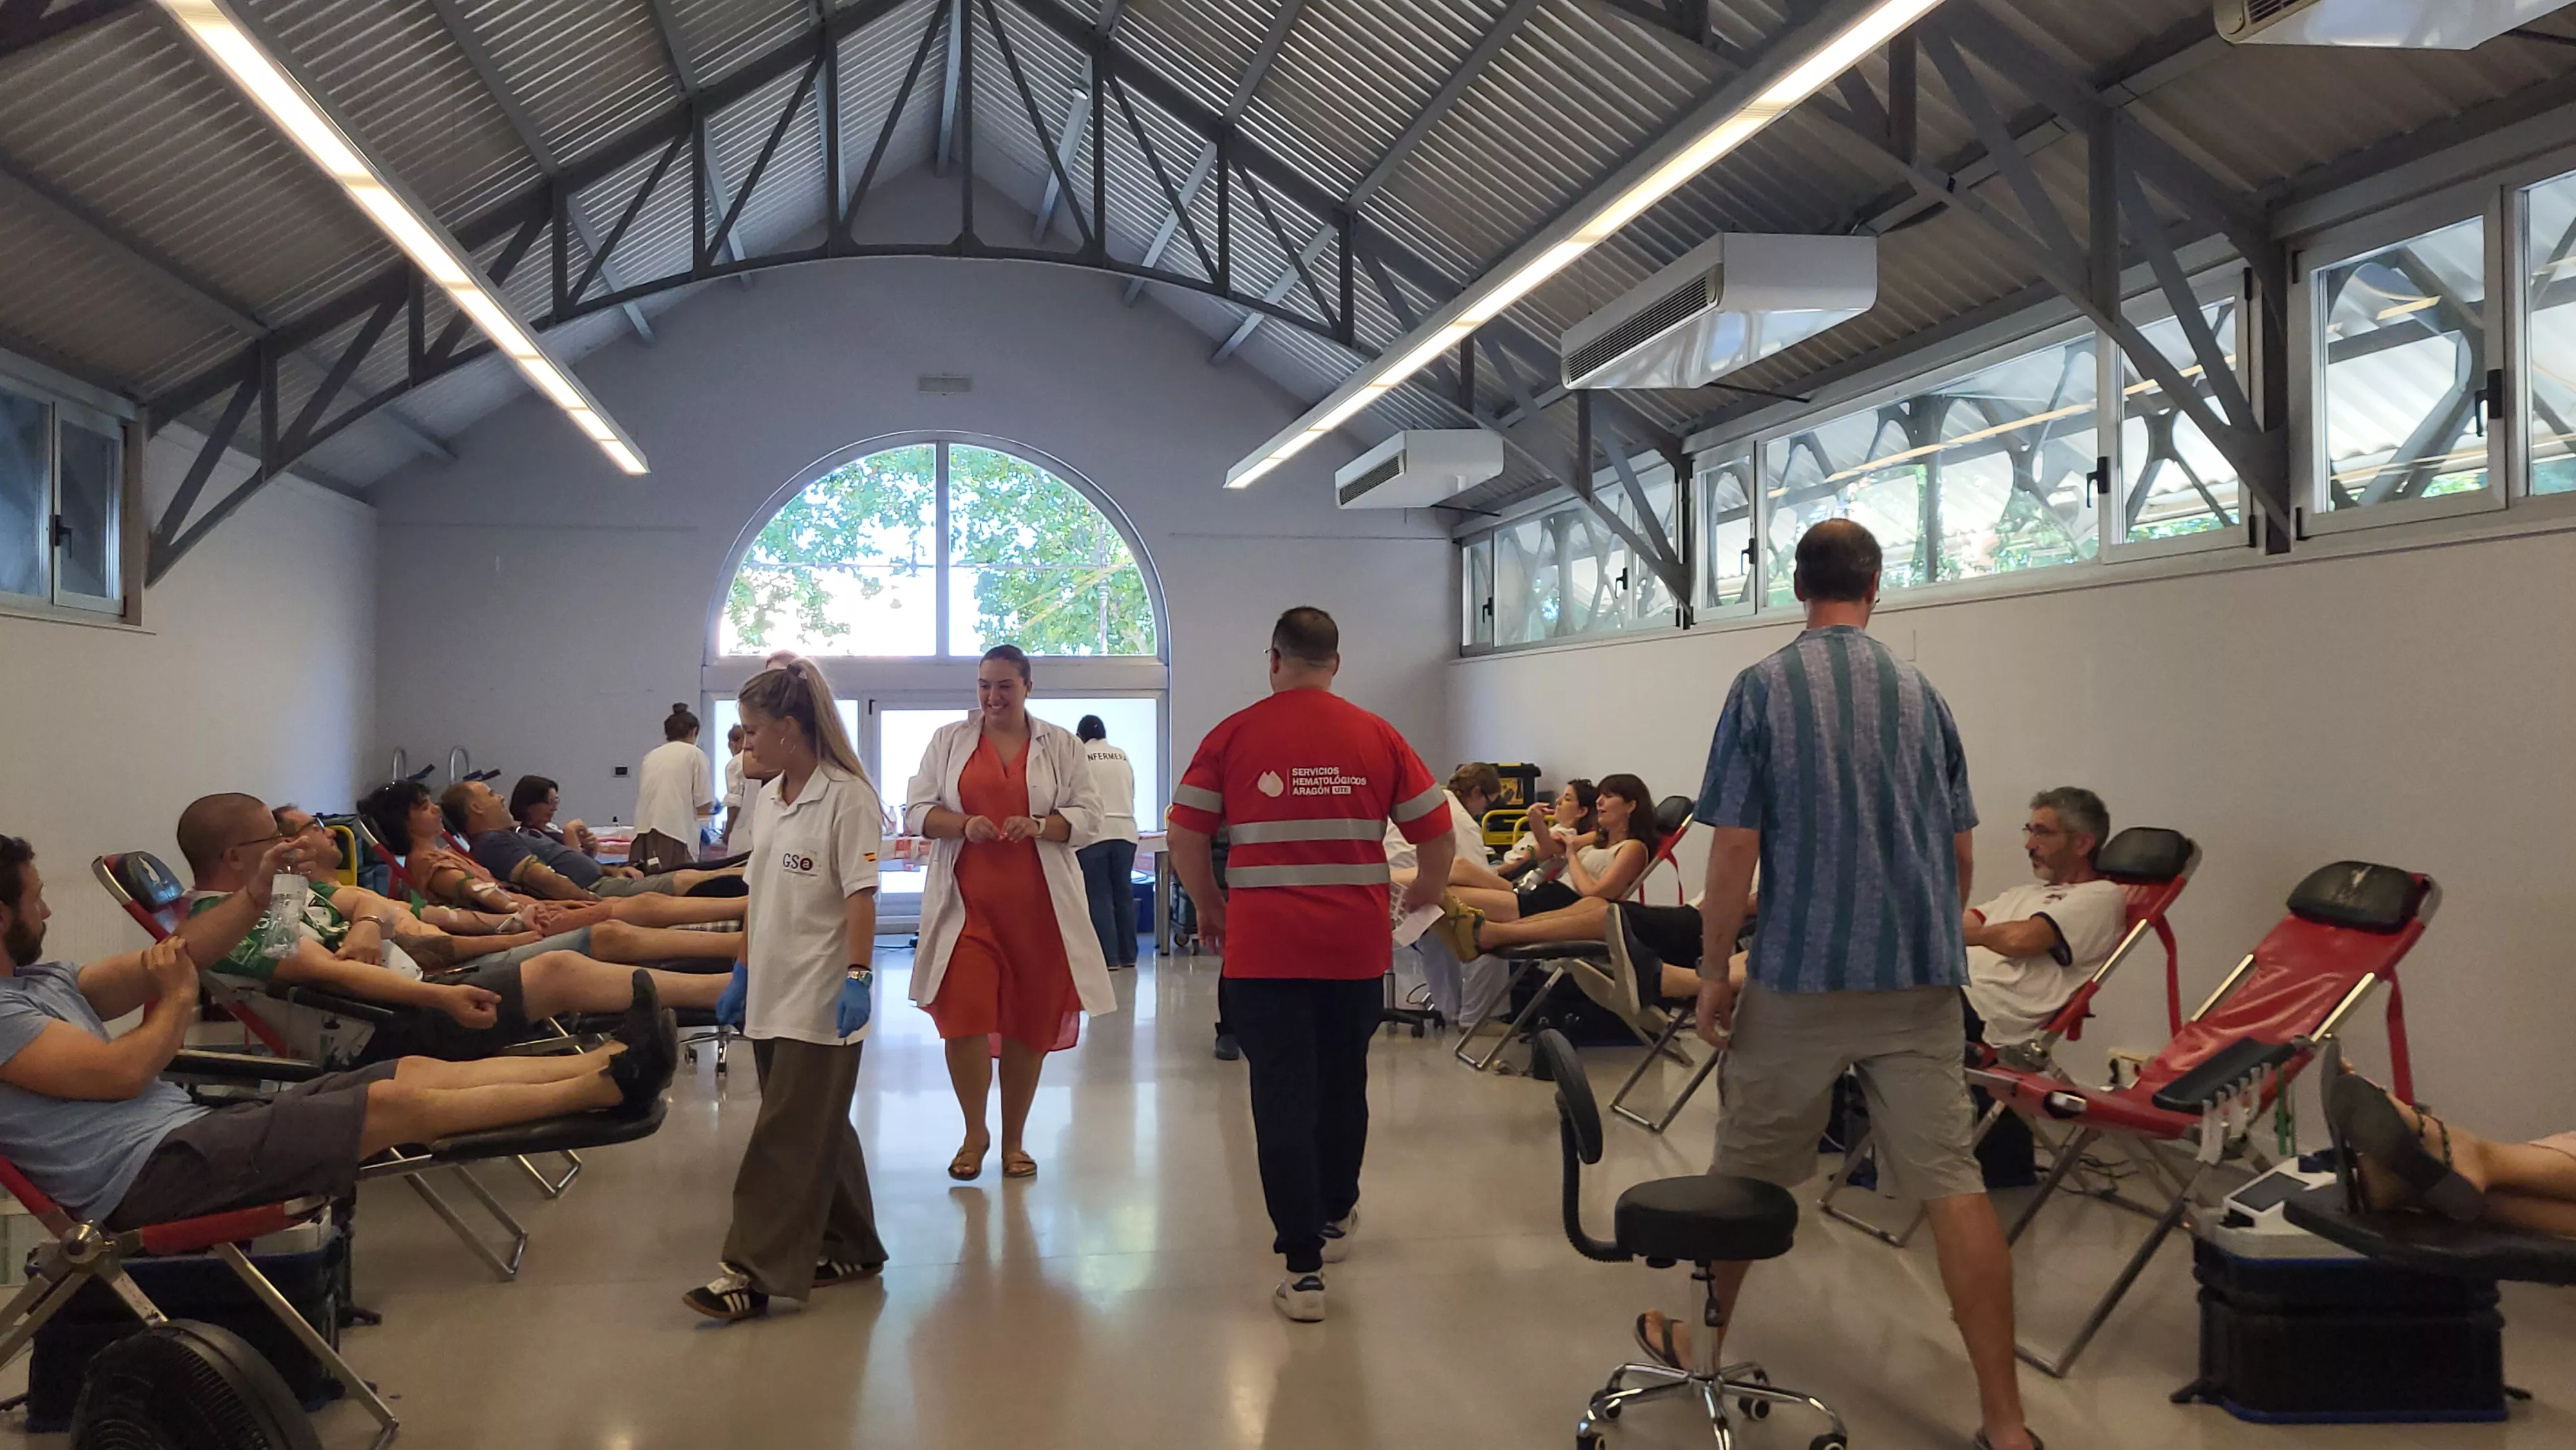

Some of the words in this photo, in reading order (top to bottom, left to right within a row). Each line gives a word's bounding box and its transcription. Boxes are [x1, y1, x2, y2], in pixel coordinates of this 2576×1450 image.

[1292, 767, 1340, 776] SERVICIOS
[1293, 775, 1367, 786] HEMATOLÓGICOS
[1293, 786, 1330, 795] ARAGÓN
